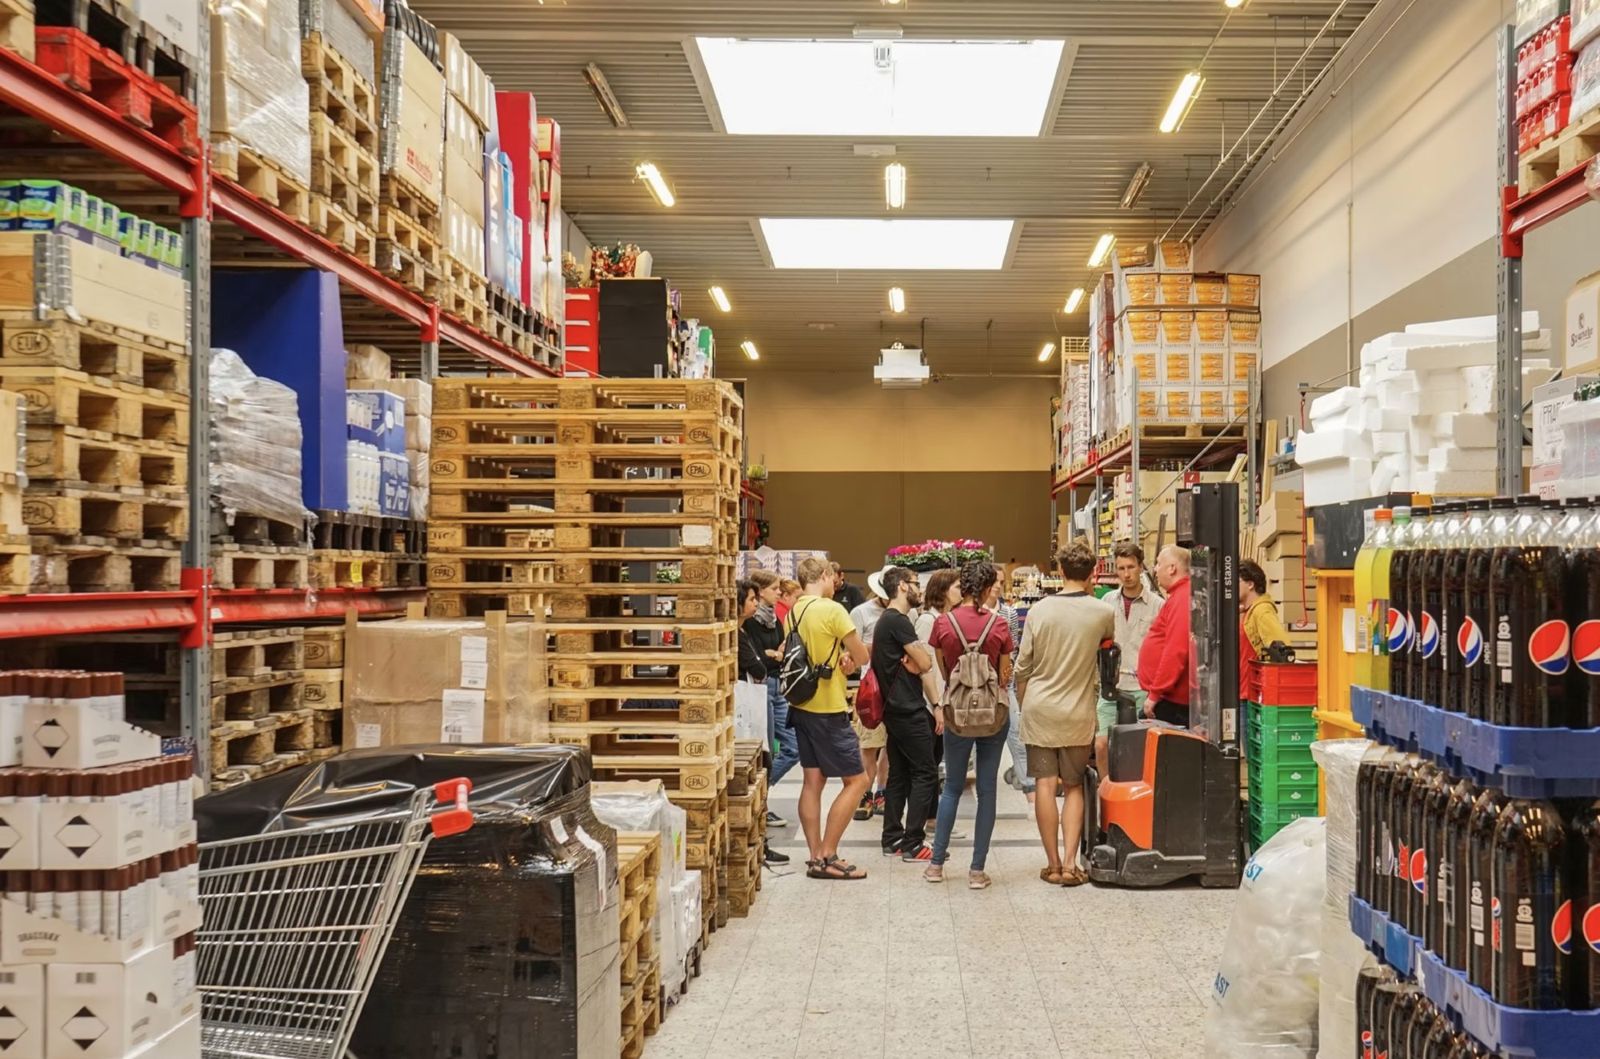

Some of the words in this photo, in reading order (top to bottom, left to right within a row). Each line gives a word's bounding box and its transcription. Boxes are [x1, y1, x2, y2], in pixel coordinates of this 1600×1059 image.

[435, 428, 454, 439] EPAL
[692, 431, 711, 440] EPAL
[435, 463, 452, 473] EPAL
[689, 465, 707, 475] EPAL
[22, 504, 48, 520] EPAL
[1224, 555, 1232, 586] staxio
[1224, 588, 1232, 600] BT
[1483, 641, 1491, 665] pepsi
[304, 687, 323, 699] EPAL
[689, 744, 705, 755] EUR
[687, 777, 706, 787] EPAL
